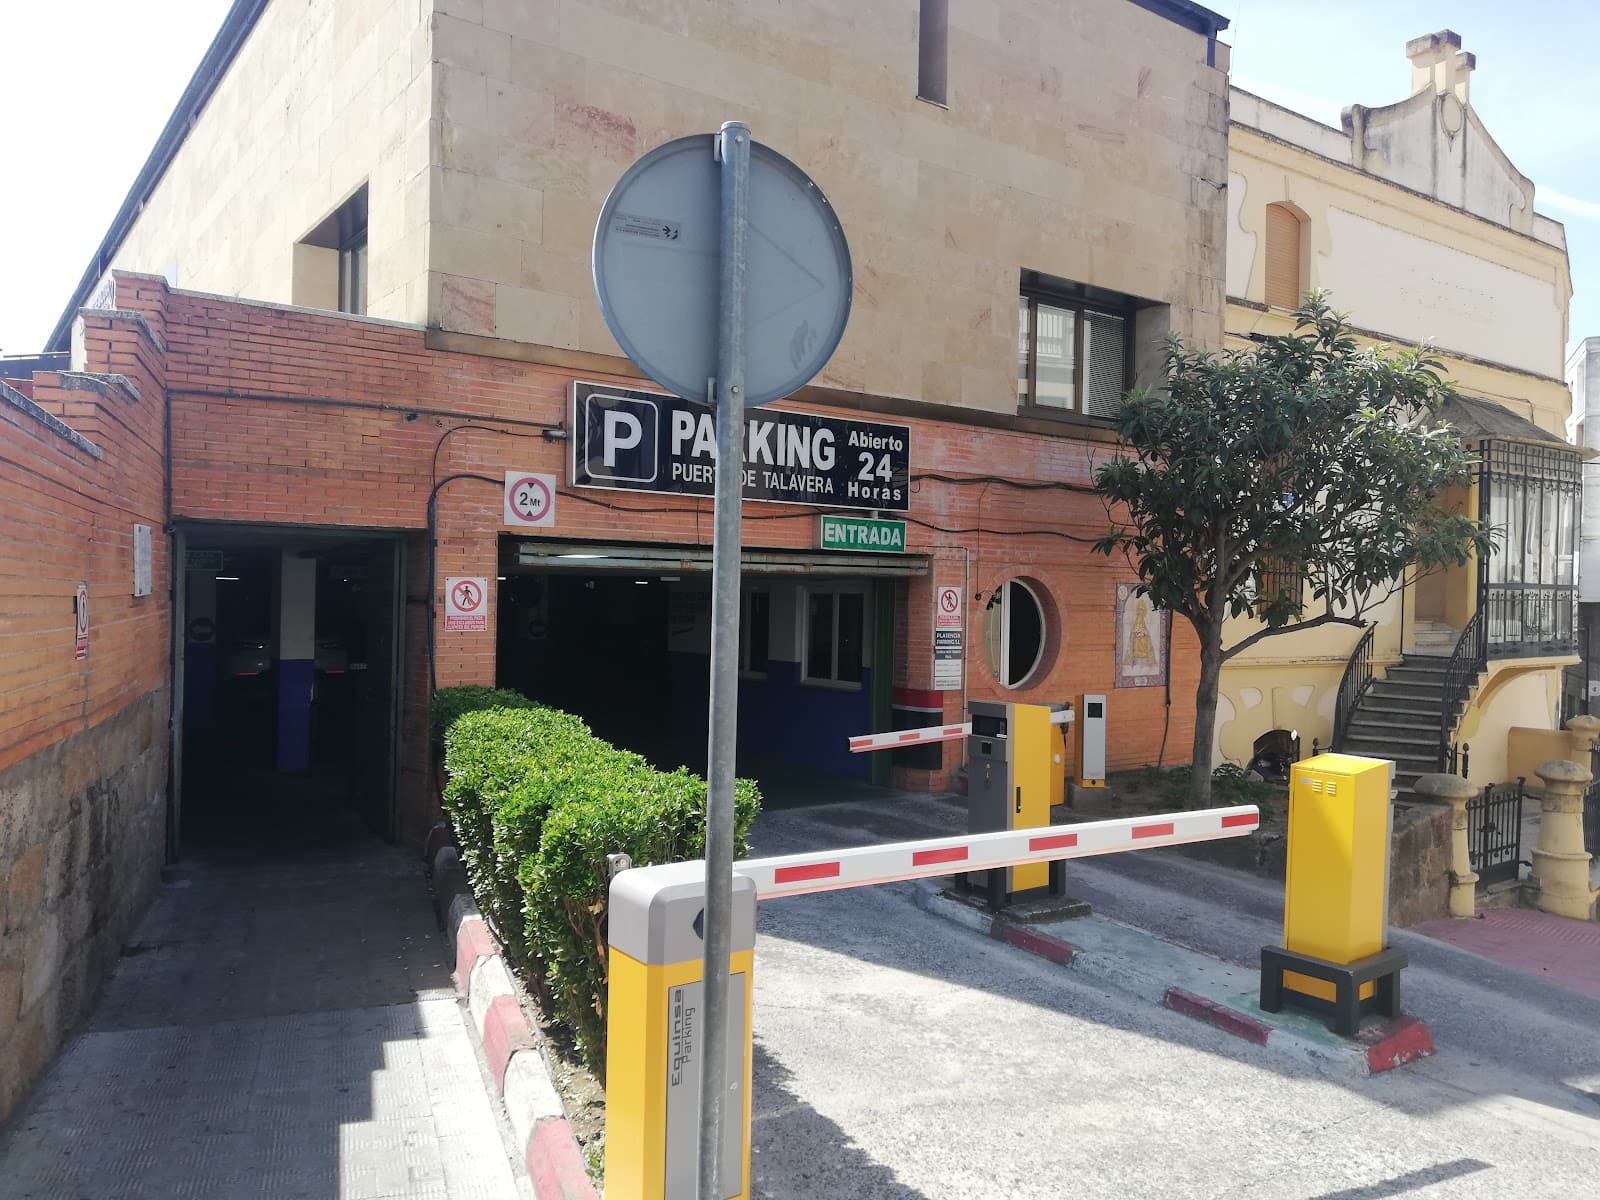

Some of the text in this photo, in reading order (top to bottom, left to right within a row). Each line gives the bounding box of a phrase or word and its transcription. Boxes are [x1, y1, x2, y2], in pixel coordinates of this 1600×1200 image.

[603, 410, 643, 467] P
[671, 409, 836, 471] PAKING
[848, 430, 903, 452] Abierto
[672, 462, 717, 483] PUER
[763, 471, 834, 494] TALAVERA
[858, 452, 892, 482] 24
[519, 492, 528, 506] 2
[848, 481, 901, 501] Horas
[824, 525, 902, 546] ENTRADA
